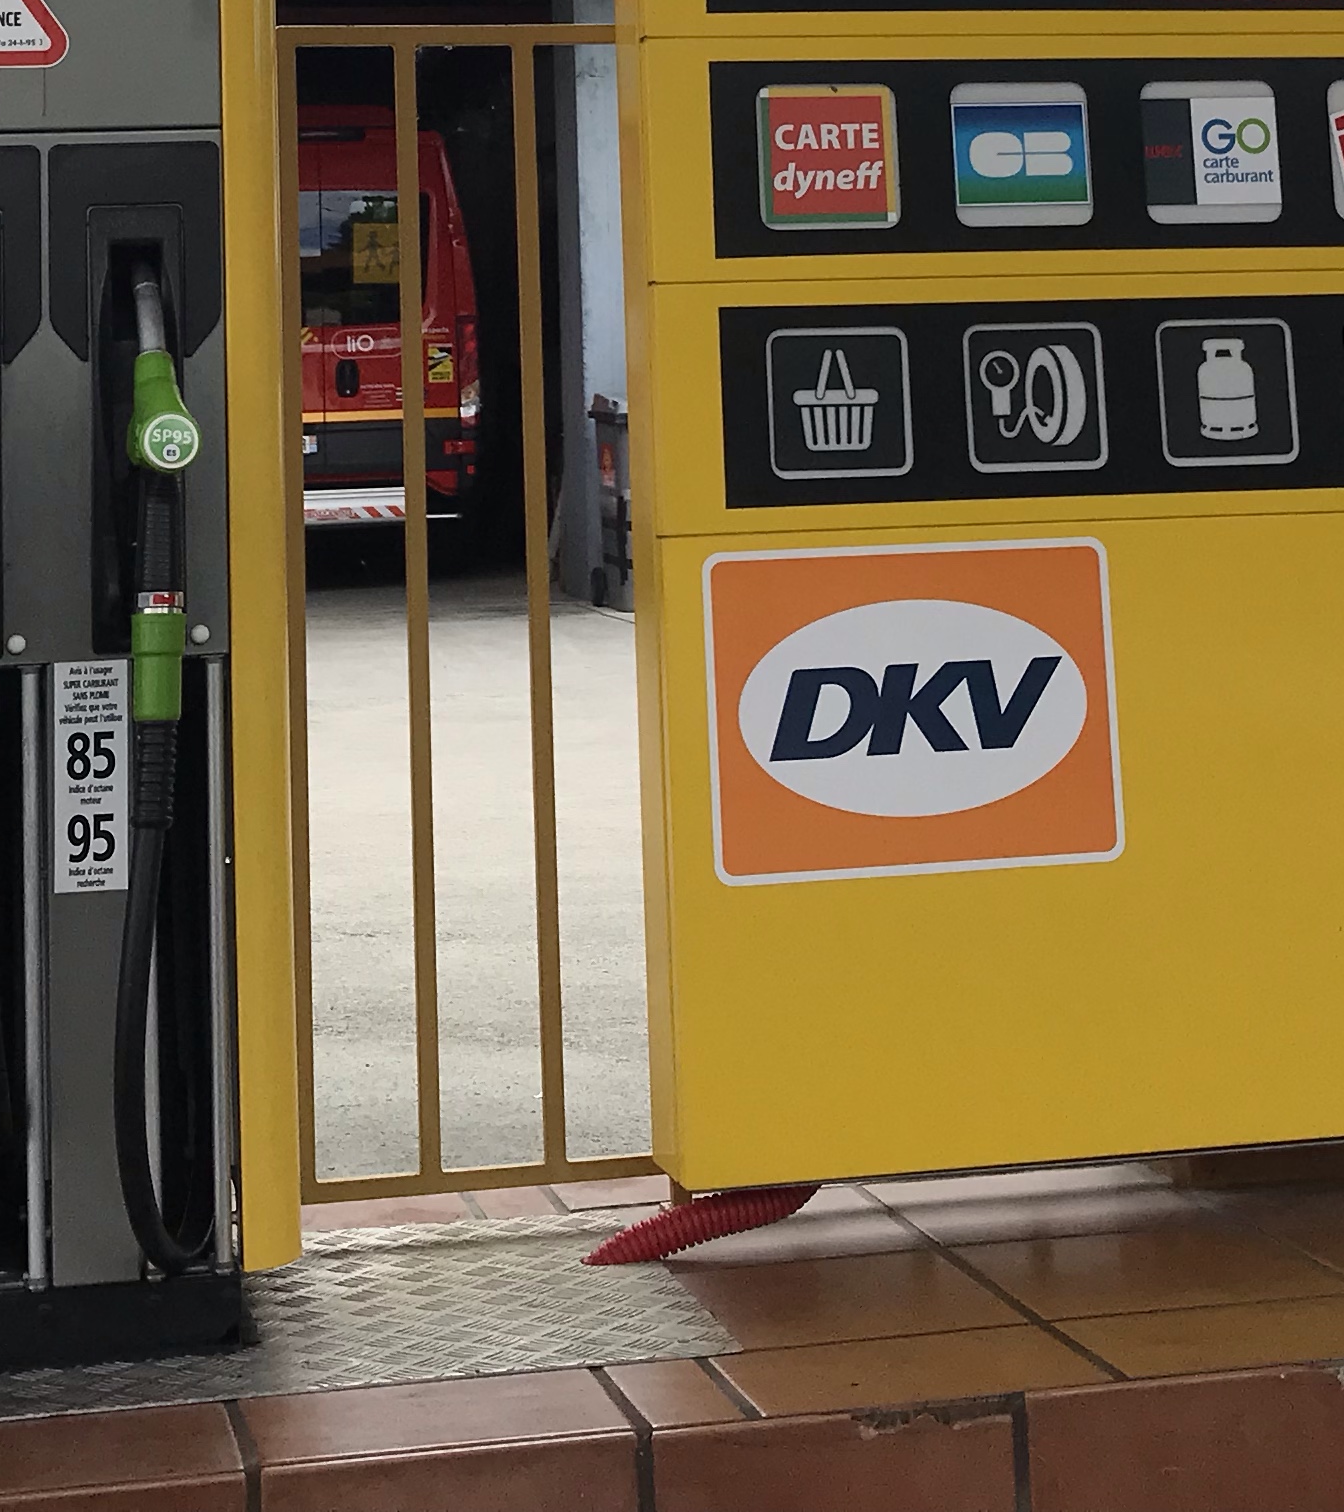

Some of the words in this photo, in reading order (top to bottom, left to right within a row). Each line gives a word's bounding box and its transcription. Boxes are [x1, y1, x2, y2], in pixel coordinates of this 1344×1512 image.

[774, 123, 881, 151] CARTE
[1201, 118, 1271, 155] GO
[1203, 156, 1239, 169] carte
[1204, 169, 1274, 184] carburant
[773, 161, 884, 199] dyneff
[152, 428, 193, 445] SP95
[63, 680, 81, 689] SUPER
[83, 678, 119, 688] CARBURANT
[72, 691, 88, 700] SANS
[769, 656, 1062, 762] DKV
[66, 731, 116, 780] 85
[67, 813, 116, 863] 95
